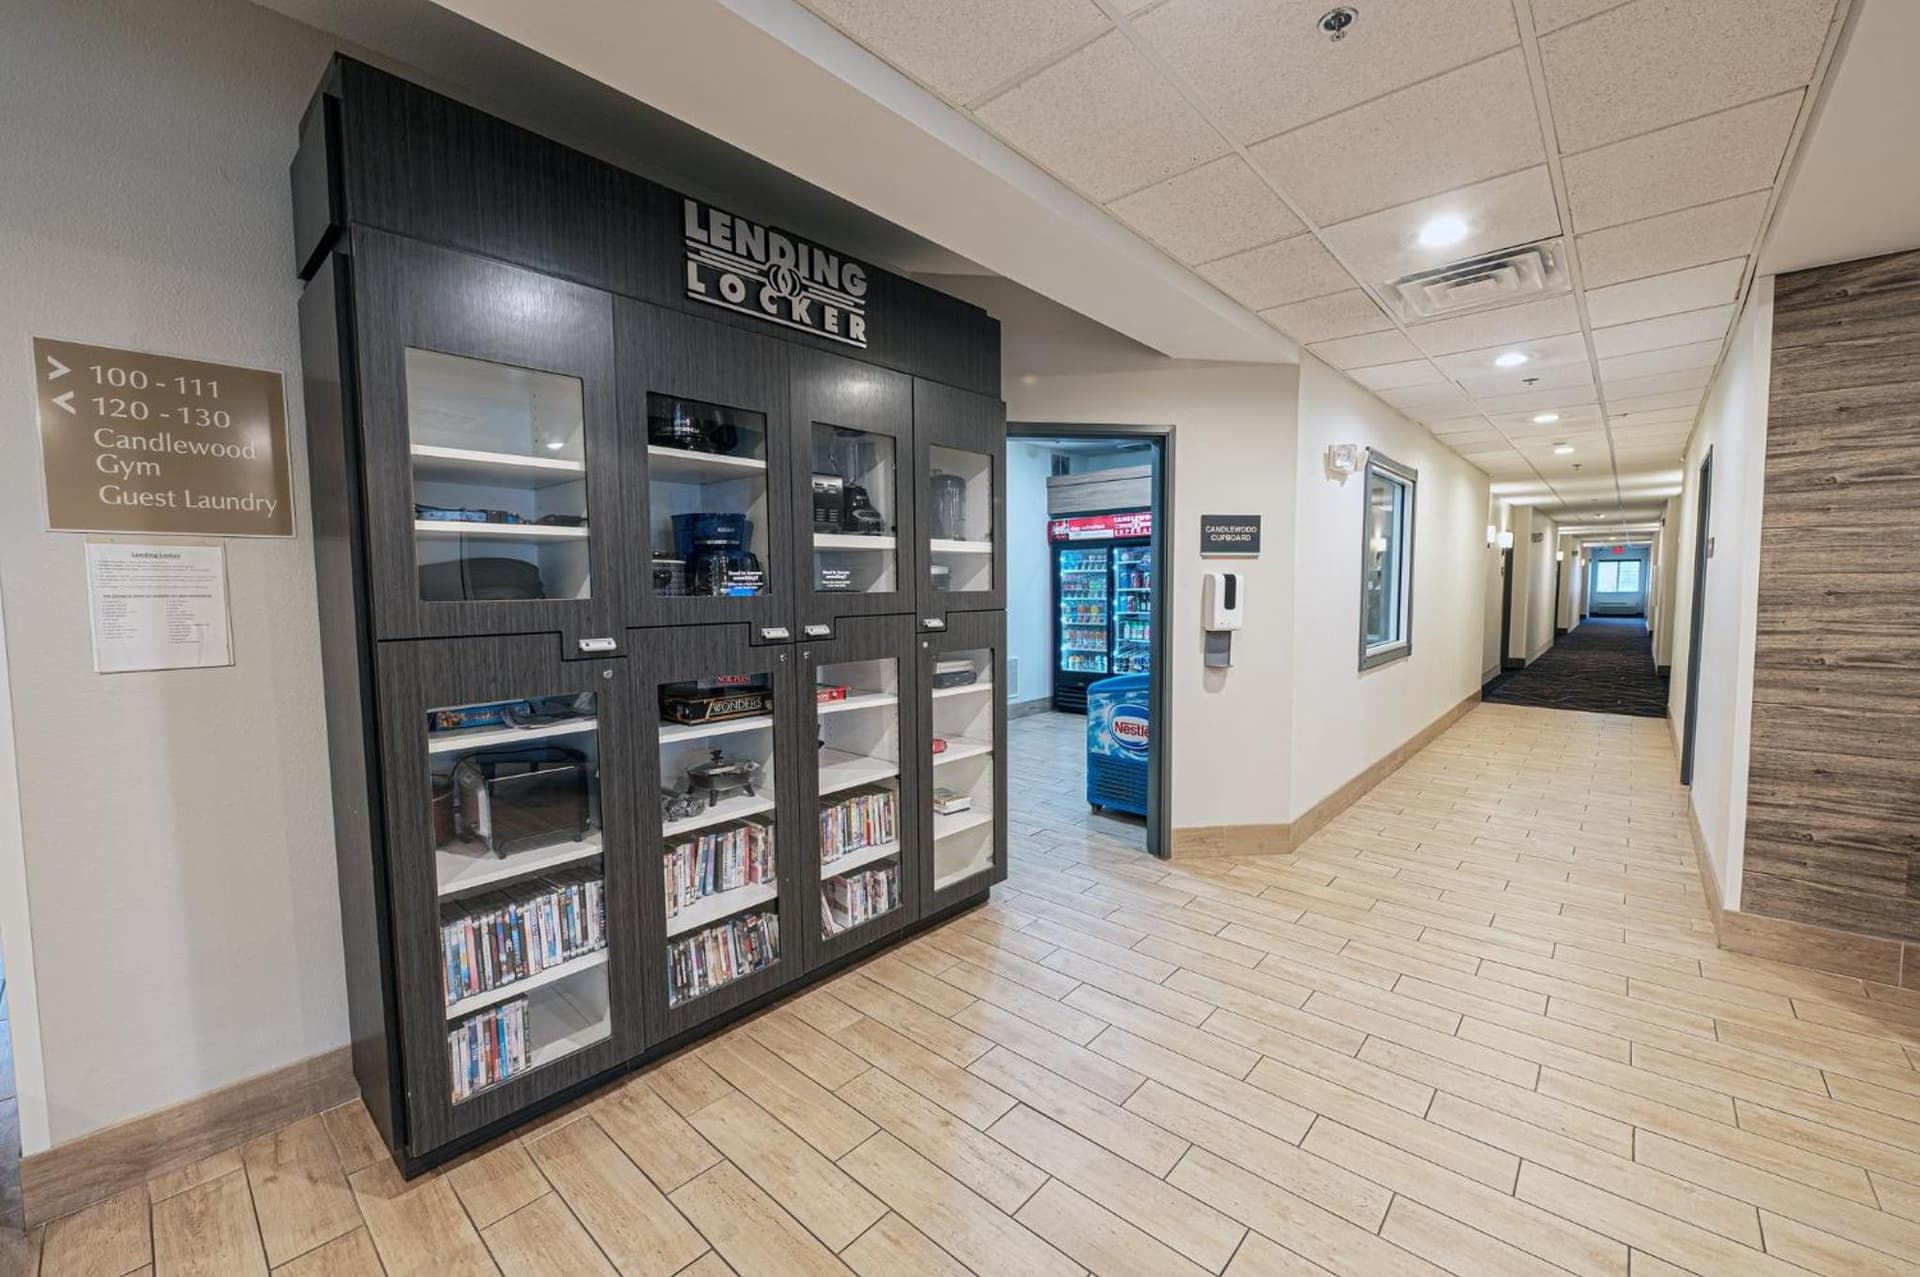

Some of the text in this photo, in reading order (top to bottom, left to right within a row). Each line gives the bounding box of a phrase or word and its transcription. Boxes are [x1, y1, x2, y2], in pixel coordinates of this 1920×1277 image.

[684, 198, 867, 296] LENDING
[687, 259, 867, 342] LOCKER
[88, 365, 148, 390] 100
[174, 376, 219, 399] 111
[91, 398, 149, 421] 120
[177, 407, 231, 429] 130
[93, 427, 257, 460] Candlewood
[95, 453, 161, 481] Gym
[98, 484, 277, 519] Guest Laundry
[1205, 525, 1257, 533] CANDLEWOOD
[712, 697, 762, 713] WONDERS
